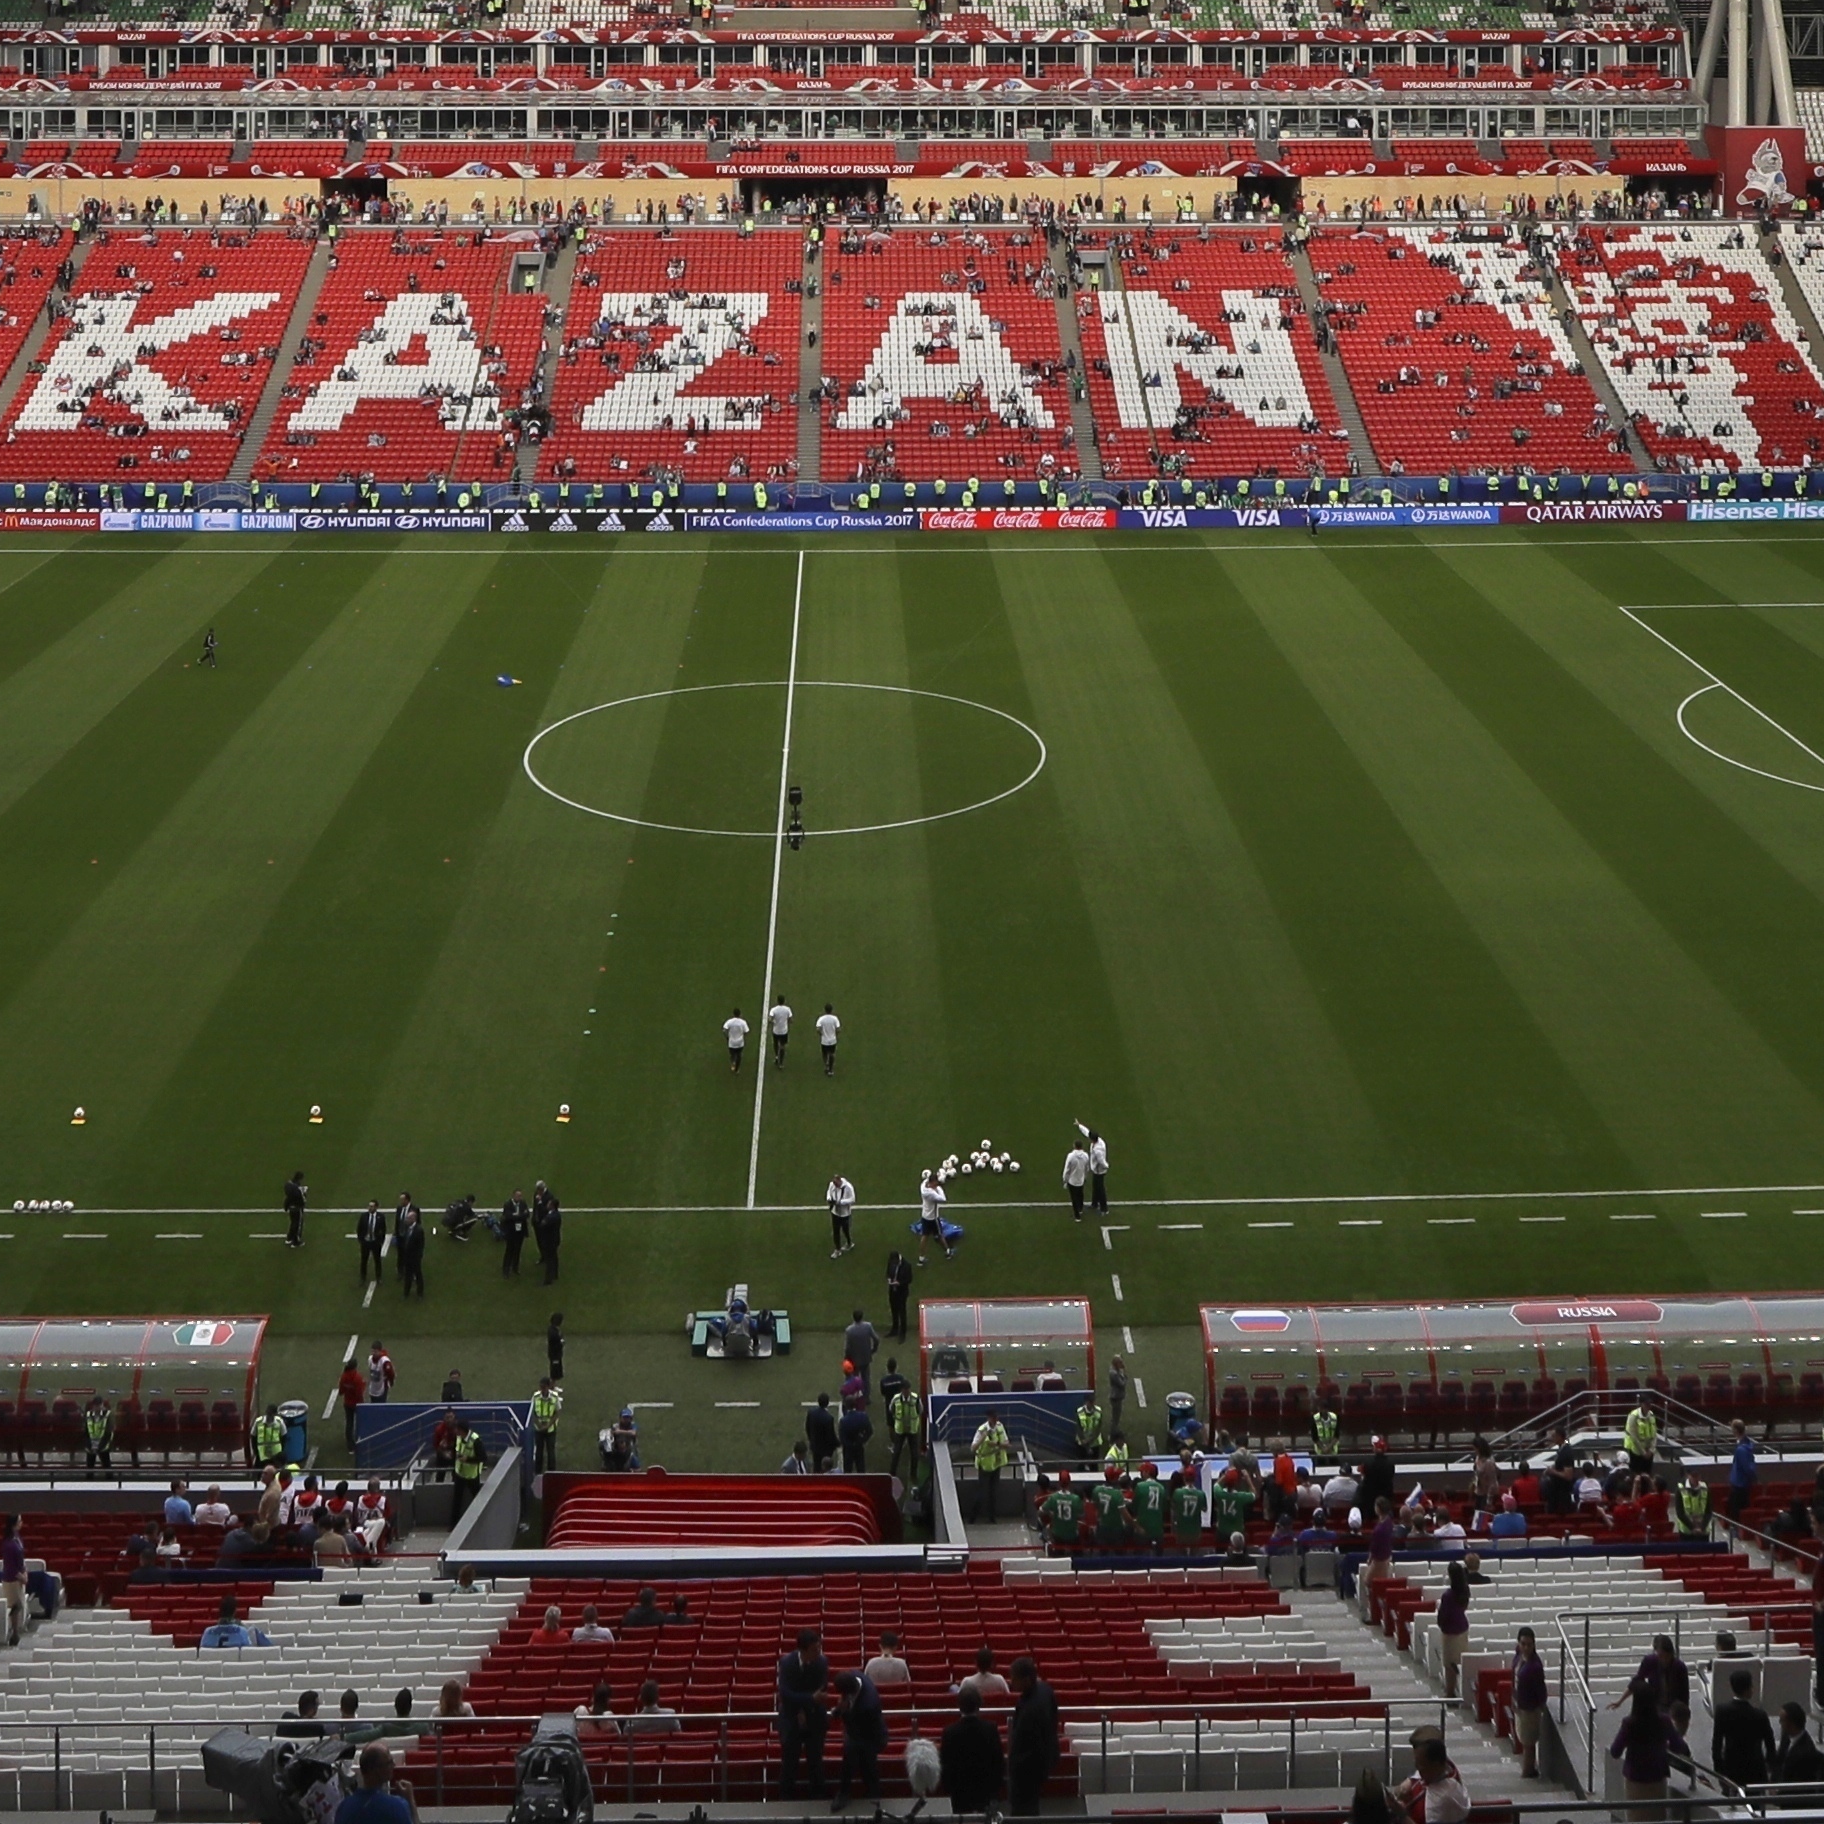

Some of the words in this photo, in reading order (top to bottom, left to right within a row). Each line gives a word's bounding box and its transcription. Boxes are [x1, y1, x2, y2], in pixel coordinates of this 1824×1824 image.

[716, 164, 738, 174] FIFA
[739, 164, 829, 174] CONFEDERATIONS
[831, 164, 851, 174] CUP
[853, 164, 891, 174] RUSSIA
[892, 164, 914, 174] 2017
[1646, 163, 1687, 172] КАЗАНЬ
[12, 290, 1316, 432] KAZAN
[1139, 510, 1188, 527] VISA
[1232, 509, 1281, 526] VISA
[1527, 506, 1585, 523] QATAR
[1589, 504, 1663, 519] AIRWAYS
[1690, 504, 1777, 520] Hisense
[20, 516, 96, 527] Макдоналдс
[141, 514, 193, 529] GAZPROM
[241, 514, 293, 529] GAZPROM
[328, 517, 390, 527] HYUNDAI
[423, 517, 484, 527] HYUNDAI
[692, 516, 720, 527] FIFA
[723, 515, 812, 527] Confederations
[815, 515, 839, 529] Cup
[841, 515, 882, 527] Russia
[885, 515, 913, 527] 2017
[1557, 1306, 1618, 1317] RUSSIA
[1099, 1495, 1112, 1514] 7
[1148, 1486, 1159, 1509] 21
[1057, 1503, 1072, 1521] 13
[1183, 1498, 1197, 1516] 17
[1222, 1498, 1236, 1515] 14
